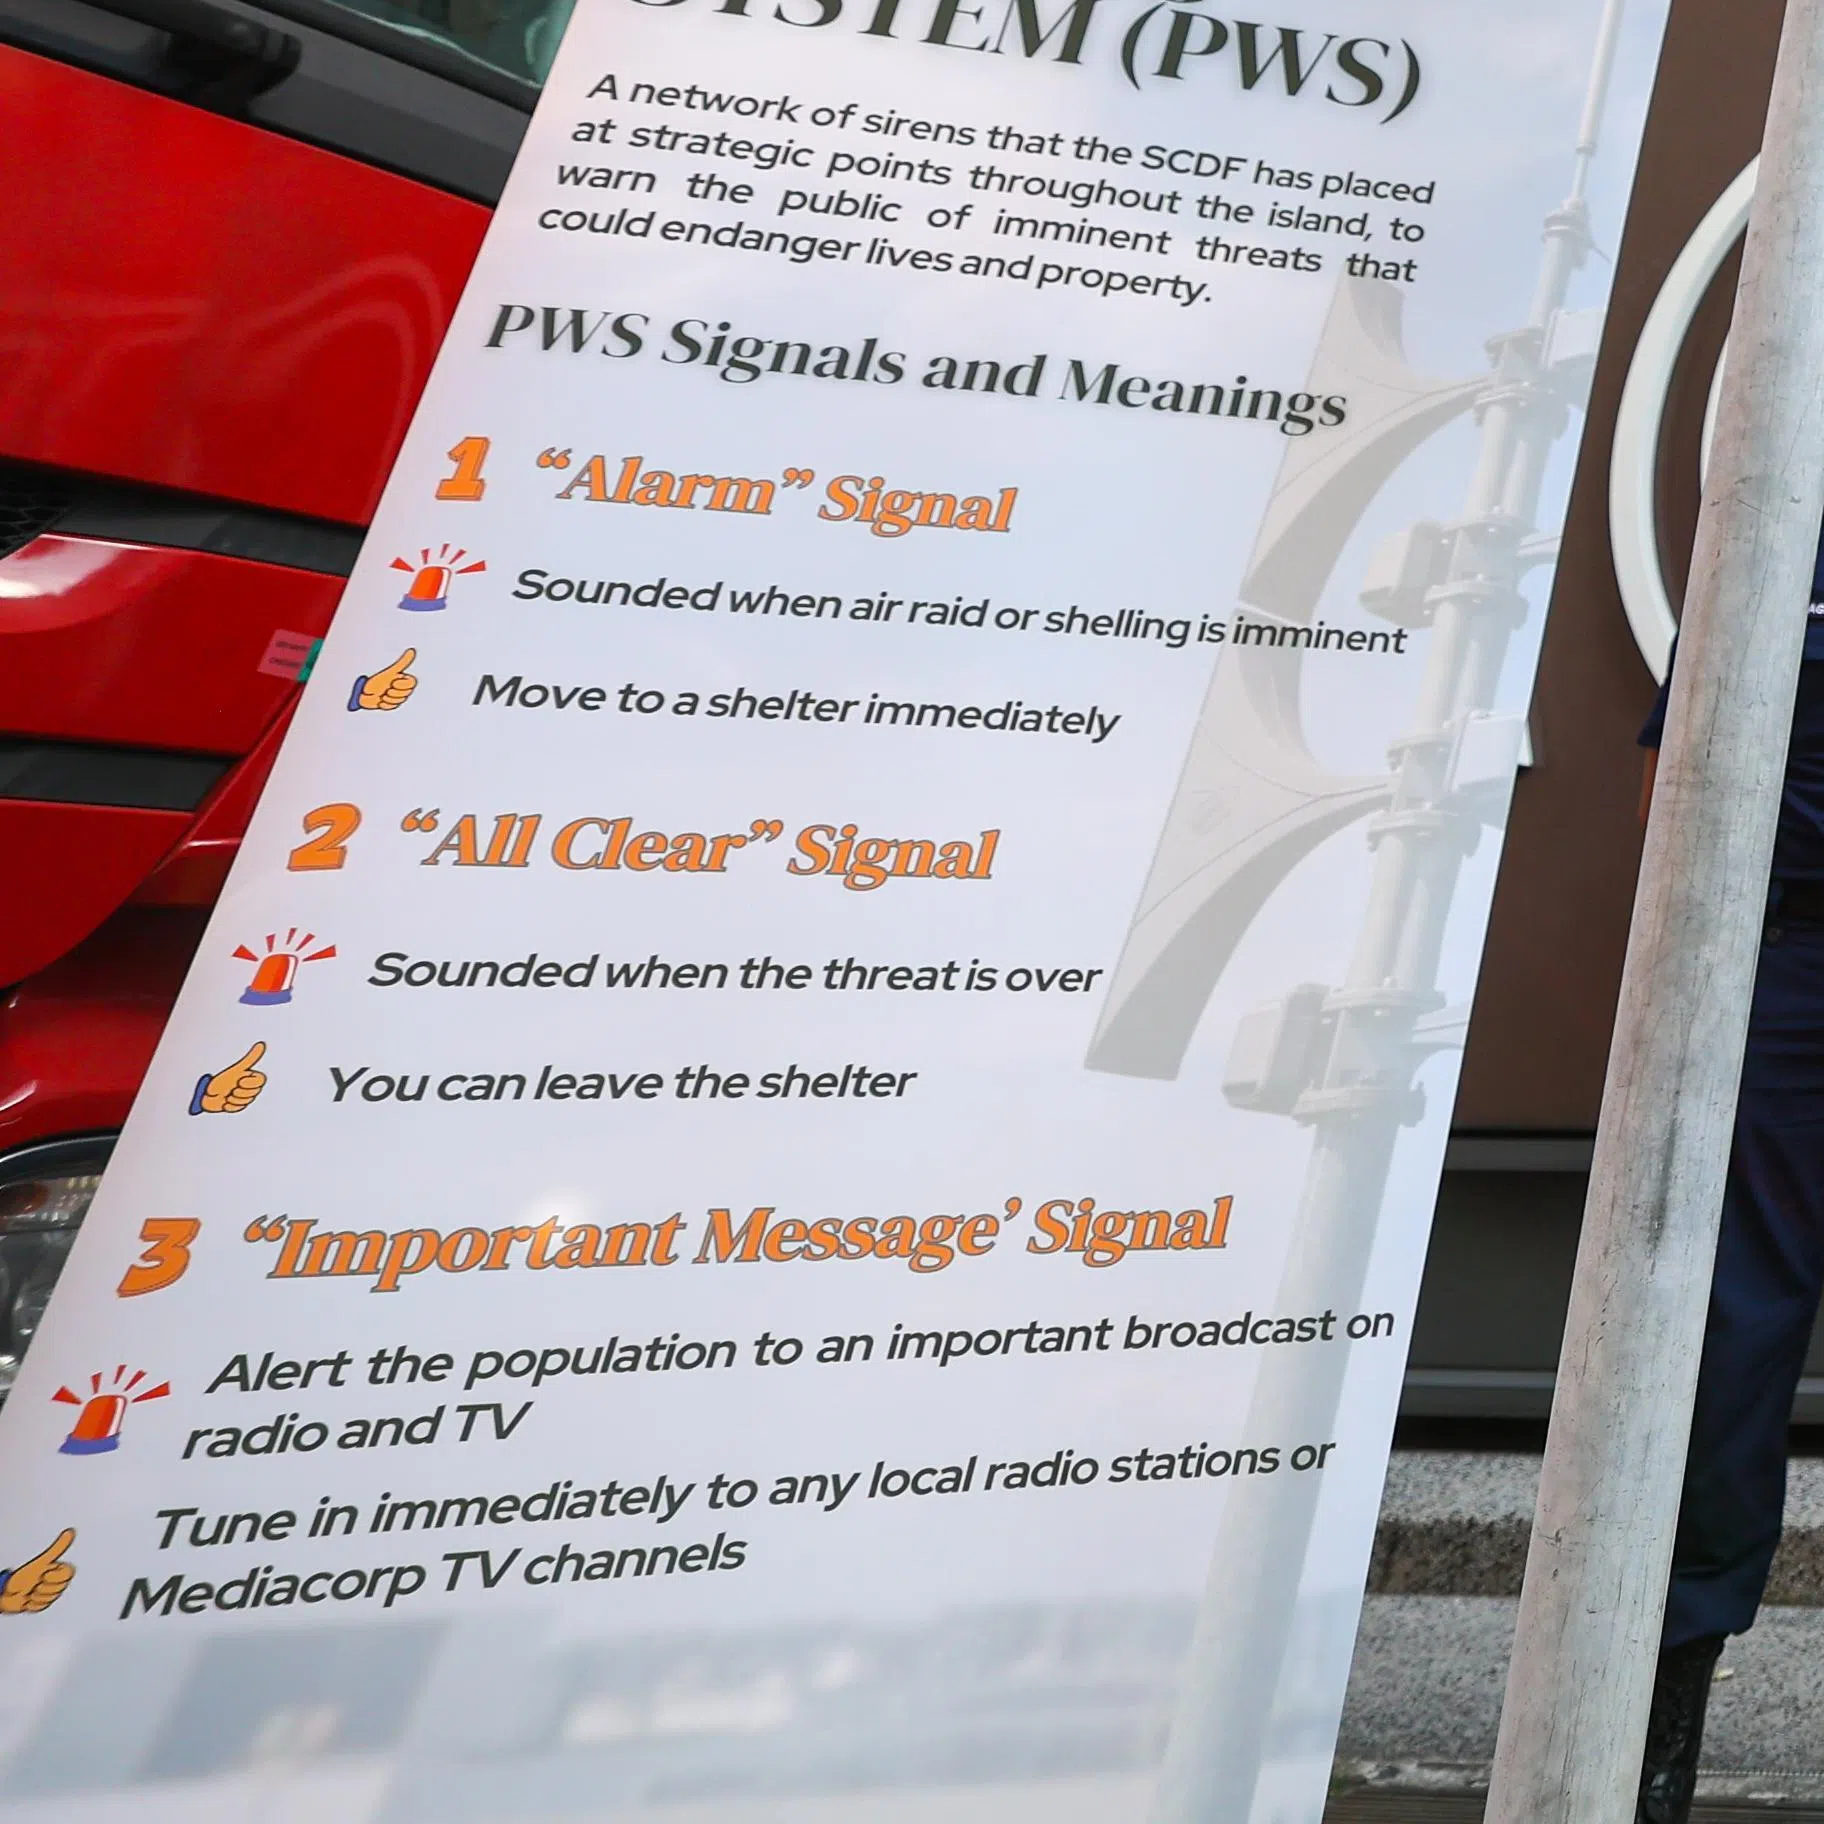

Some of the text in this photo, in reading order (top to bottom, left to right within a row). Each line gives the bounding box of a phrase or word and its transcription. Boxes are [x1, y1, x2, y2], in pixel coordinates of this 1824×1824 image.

[1121, 2, 1420, 124] (PWS)
[571, 119, 1424, 242] at strategic points throughout the island, to
[586, 74, 1435, 204] A network of sirens that the SCDF has placed
[538, 208, 1211, 307] could endanger lives and property.
[558, 165, 1418, 282] warn the public of imminent threats that
[484, 305, 1346, 436] PWS Signals and Meanings
[435, 437, 490, 501] 1
[818, 476, 1018, 537] Signal
[512, 569, 1408, 654] Sounded when air raid or shelling is imminent
[472, 675, 1121, 743] Move to a shelter immediately
[287, 803, 361, 872] 2
[786, 824, 1000, 891] Signal
[367, 952, 1103, 992] Sounded when the threat is over
[330, 1064, 918, 1102] You can leave the shelter
[117, 1218, 201, 1297] 3
[1026, 1195, 1233, 1268] Signal
[204, 1309, 1394, 1394] Alert the population to an important broadcast on
[182, 1401, 534, 1459] radio and TV
[156, 1442, 1336, 1549] Tune in immediately to any local radio stations or
[119, 1532, 748, 1620] Mediacorp TV channels
